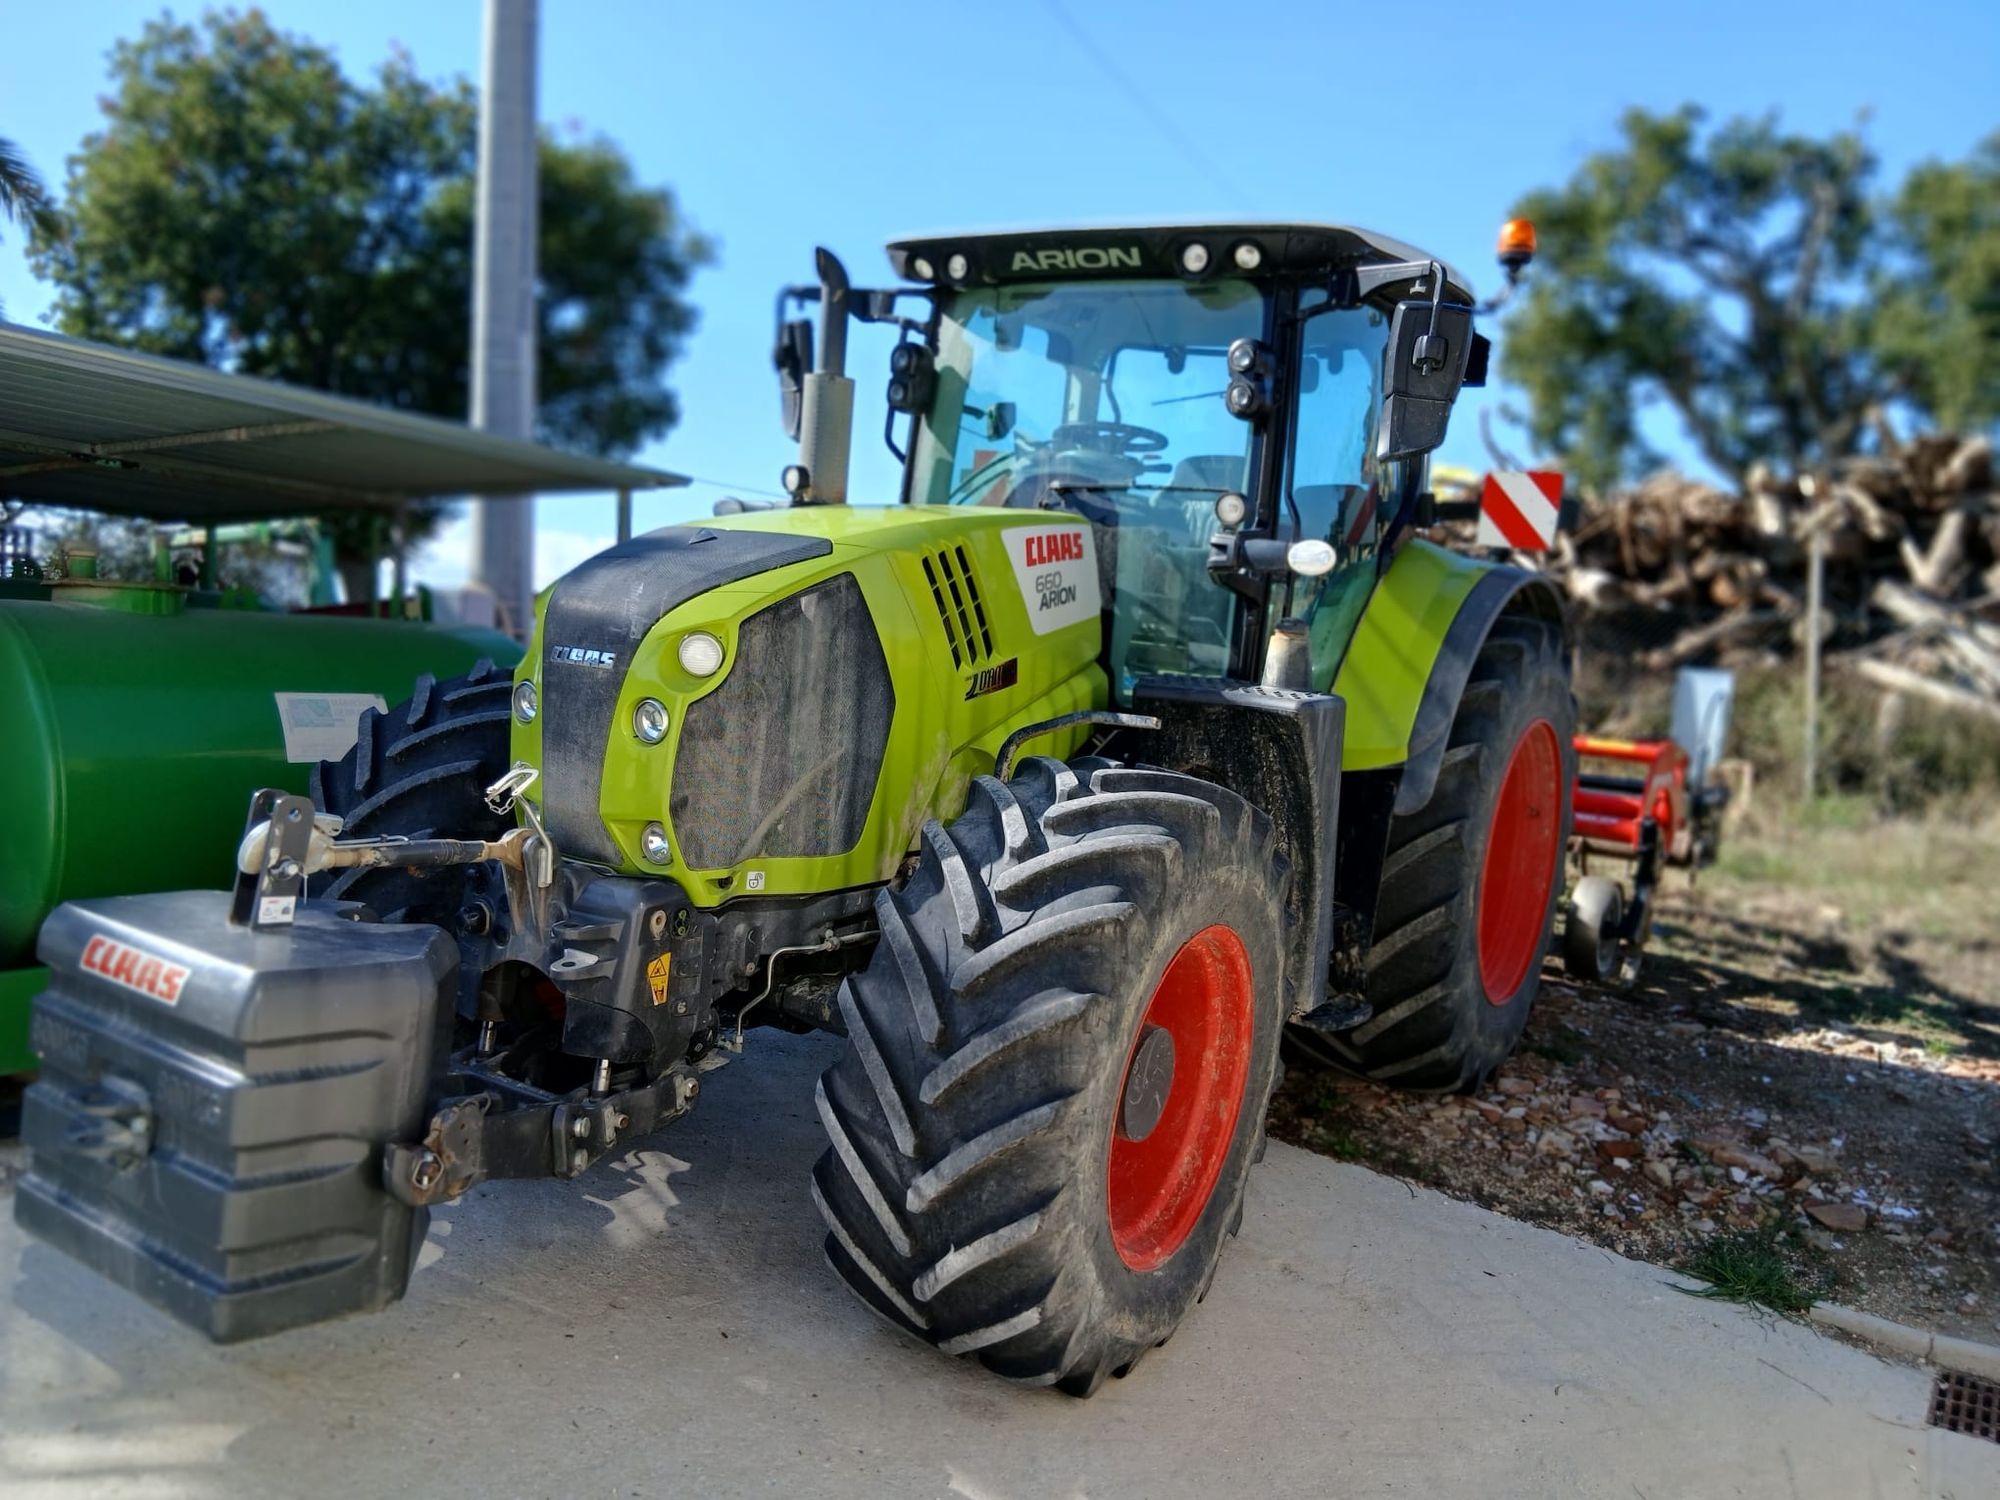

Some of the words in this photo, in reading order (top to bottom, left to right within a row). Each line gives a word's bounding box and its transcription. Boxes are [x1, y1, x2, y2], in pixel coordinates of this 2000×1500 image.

[1011, 246, 1142, 271] ARION
[1025, 532, 1084, 568] CLAAS
[1035, 571, 1062, 594] 660
[1039, 584, 1077, 611] ARION
[82, 937, 186, 1002] CLAAS
